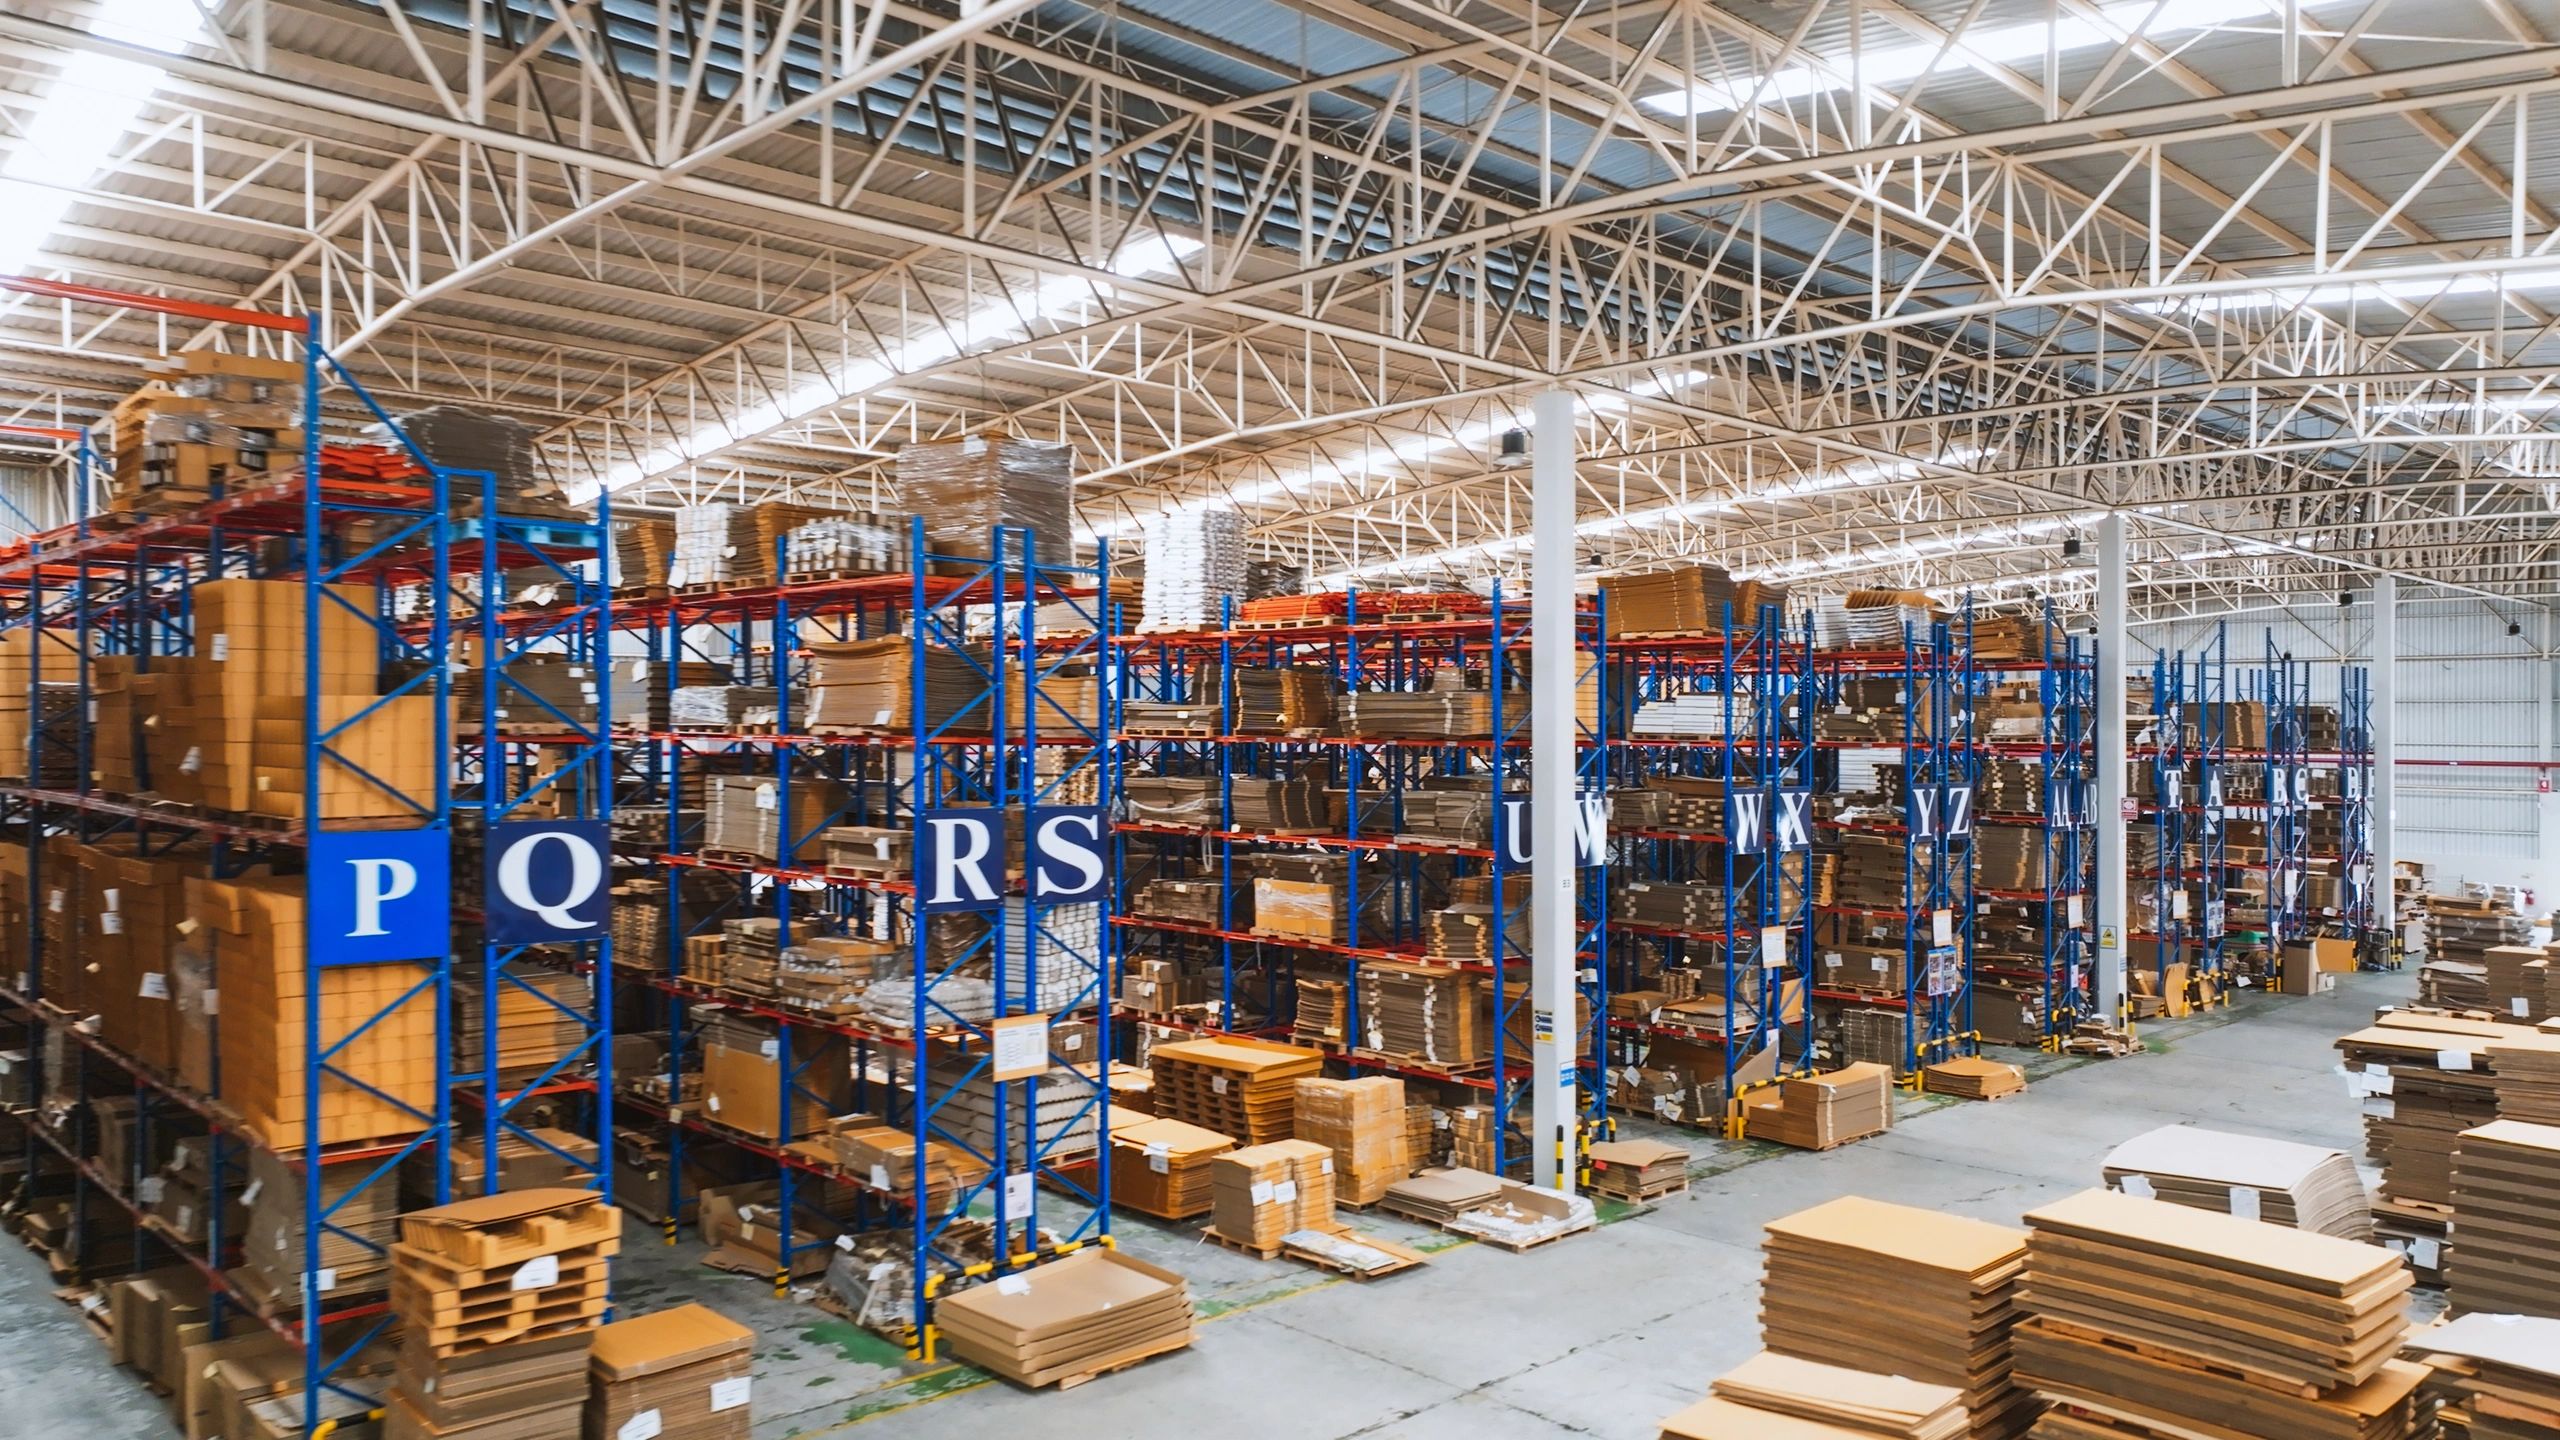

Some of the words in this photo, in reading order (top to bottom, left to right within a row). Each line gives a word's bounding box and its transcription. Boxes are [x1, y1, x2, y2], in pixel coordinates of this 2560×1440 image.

[2051, 784, 2070, 828] AA
[2079, 783, 2098, 825] AB
[2164, 769, 2182, 808] T
[2207, 769, 2224, 807] A
[2271, 768, 2287, 804] B
[2347, 766, 2359, 799] D
[1502, 801, 1532, 864] U
[1733, 793, 1764, 848] W
[1780, 792, 1811, 847] X
[1913, 788, 1935, 837] Y
[1948, 787, 1971, 835] Z
[926, 817, 1000, 904] R
[1036, 814, 1104, 897] S
[345, 858, 418, 937] P
[497, 831, 603, 930] Q
